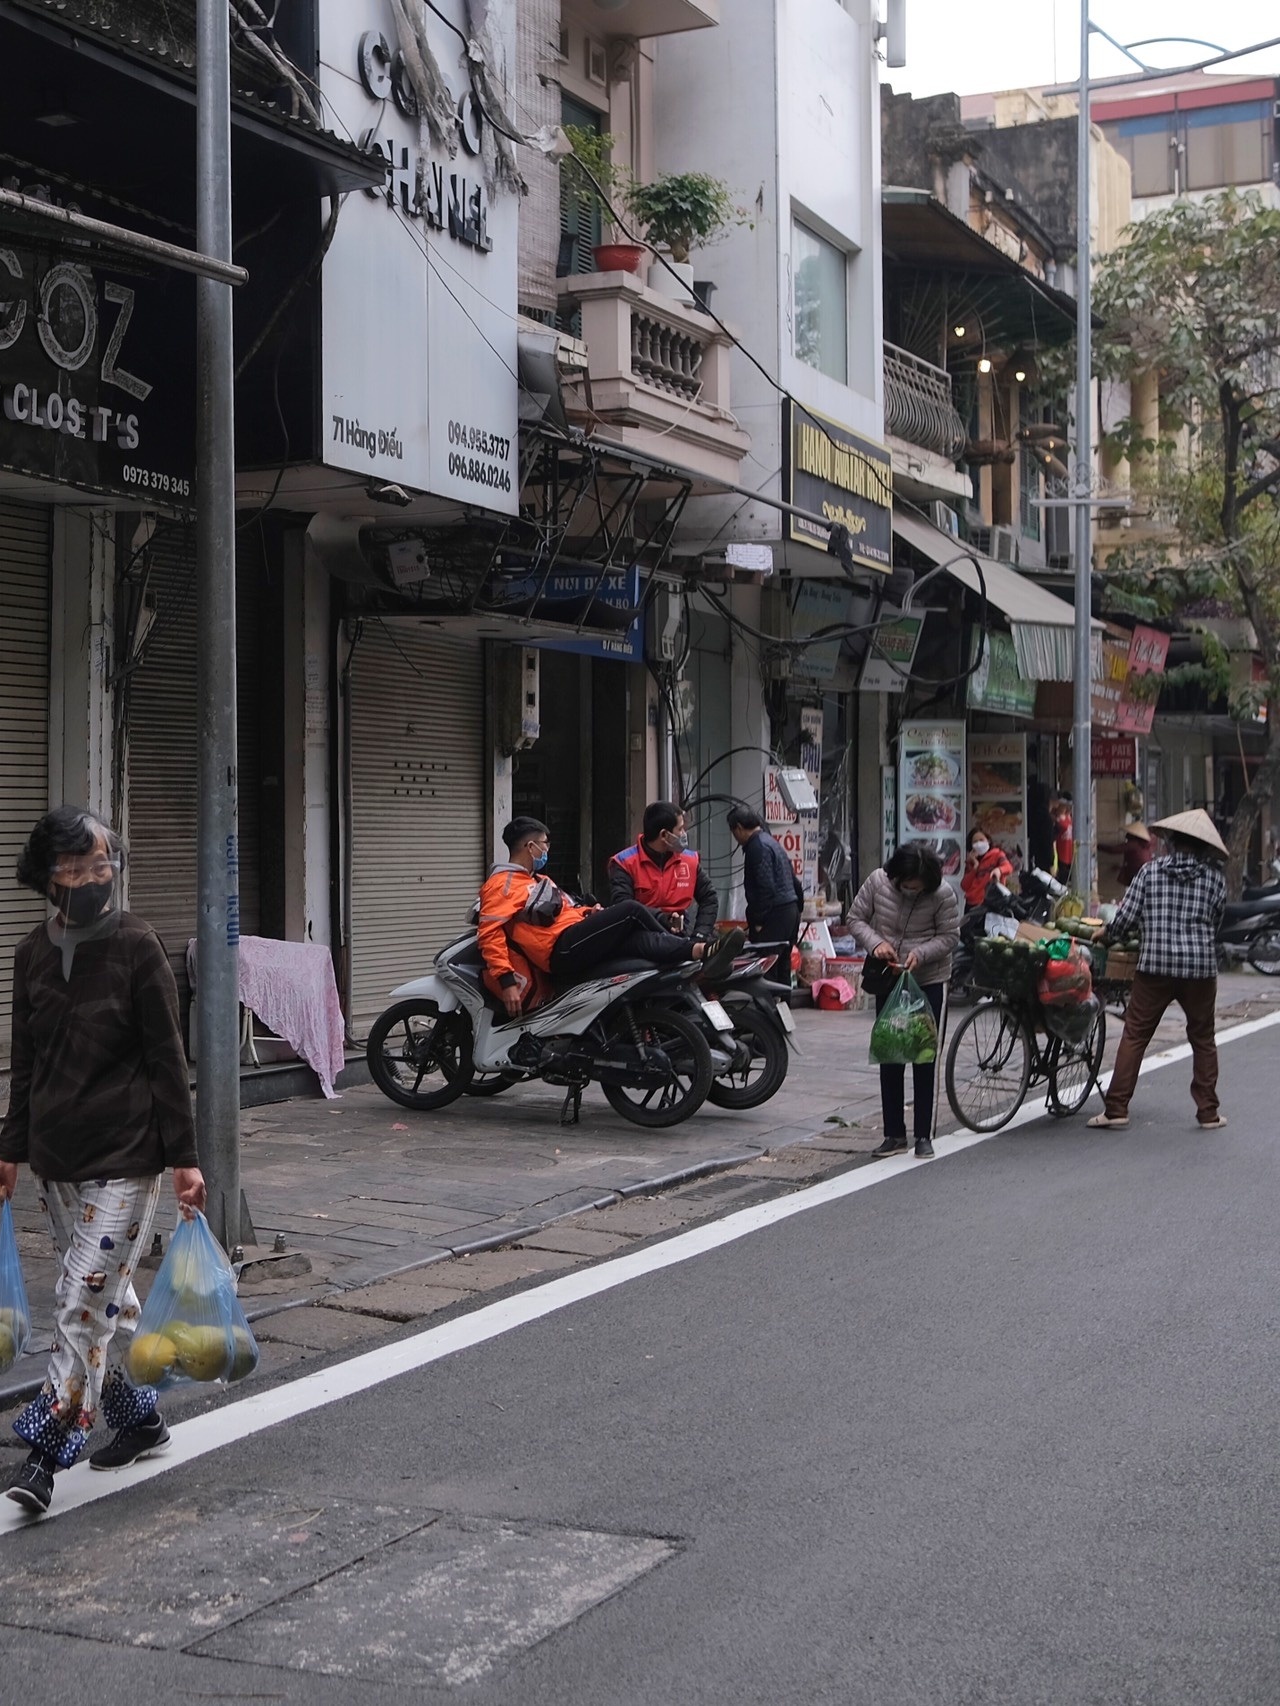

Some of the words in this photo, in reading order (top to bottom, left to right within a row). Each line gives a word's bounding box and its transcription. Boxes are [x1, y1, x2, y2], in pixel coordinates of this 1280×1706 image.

[332, 415, 344, 443] 71
[346, 418, 377, 459] Hàng
[378, 427, 403, 460] Điếu
[448, 420, 510, 461] 094.955.3737
[123, 464, 149, 486] 0973
[151, 471, 170, 492] 379
[171, 477, 190, 497] 345
[448, 452, 511, 493] 096.886.0246
